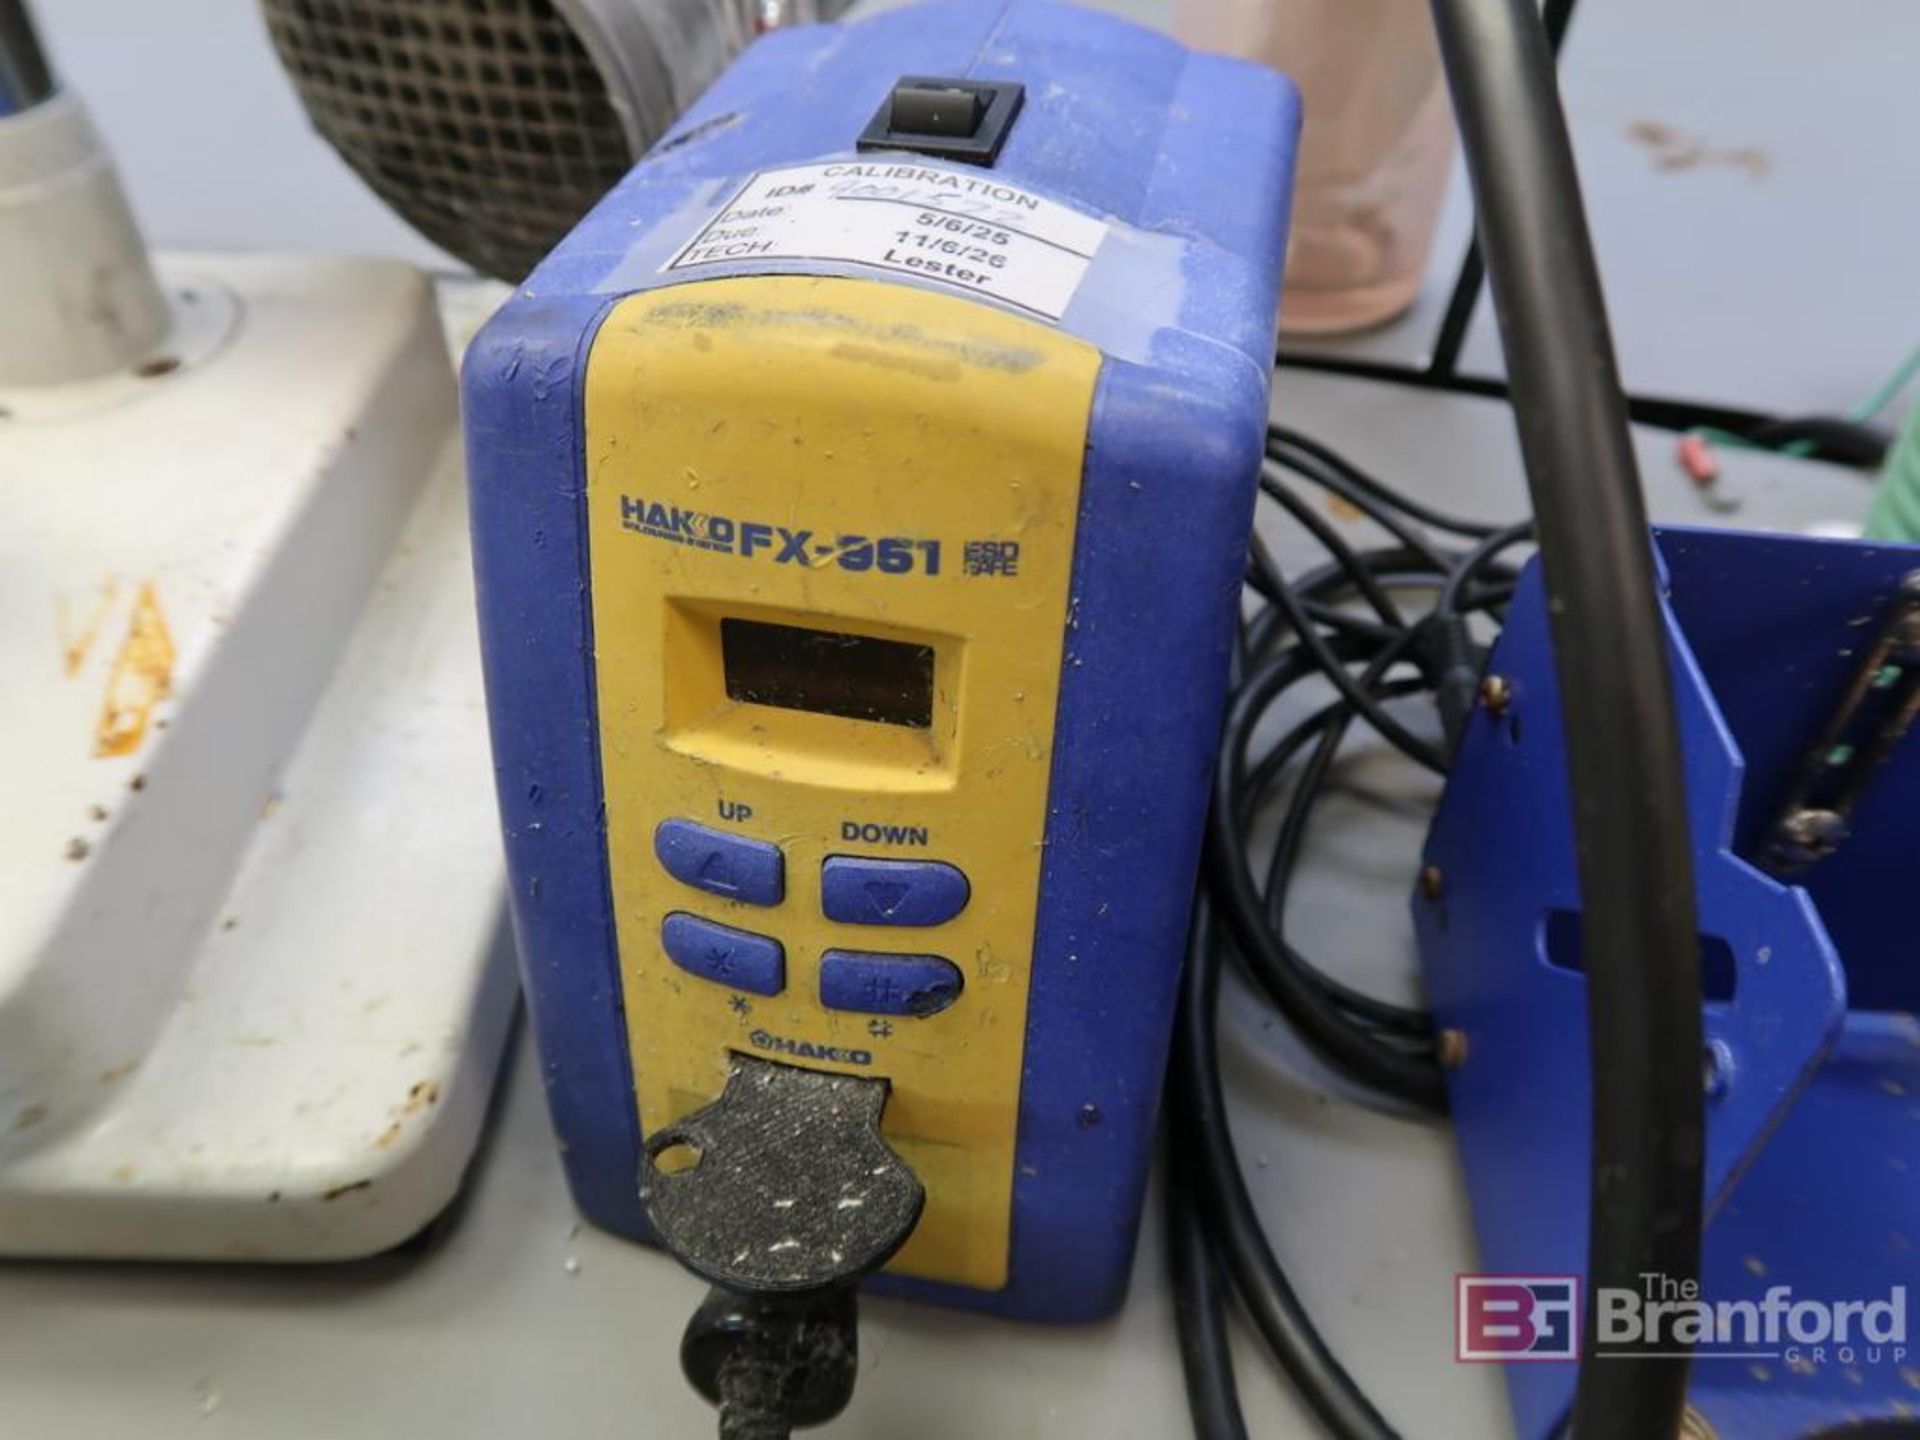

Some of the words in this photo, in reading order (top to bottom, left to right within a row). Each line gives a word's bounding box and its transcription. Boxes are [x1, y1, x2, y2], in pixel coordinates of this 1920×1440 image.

[765, 183, 816, 199] ID#
[823, 165, 1040, 210] CALIBRATION
[915, 212, 1011, 246] 5/6/25
[883, 249, 993, 285] Lester
[895, 231, 1008, 269] 11/6/26
[718, 799, 752, 822] UP
[841, 821, 929, 847] DOWN
